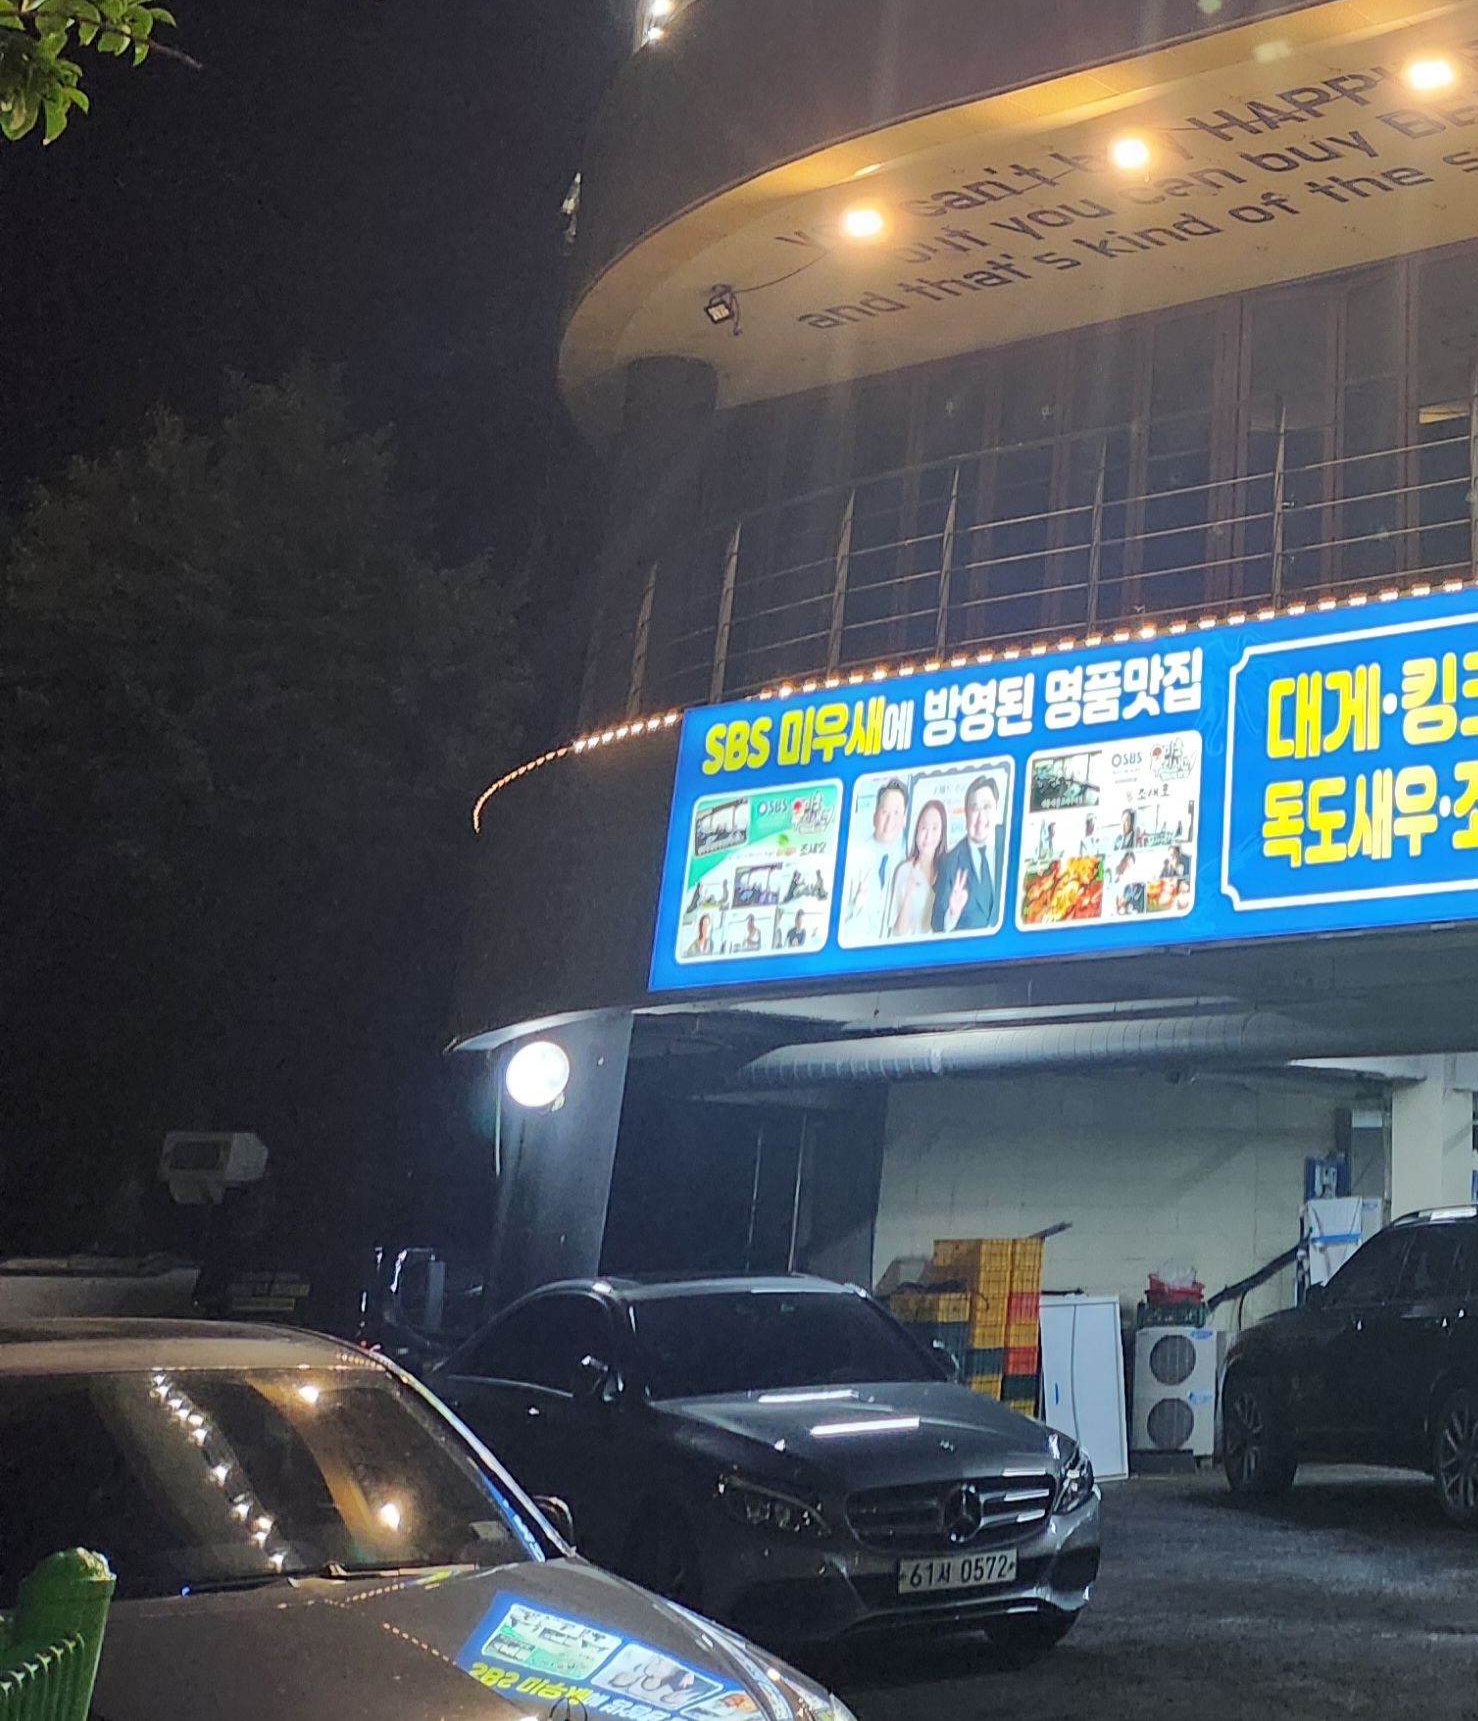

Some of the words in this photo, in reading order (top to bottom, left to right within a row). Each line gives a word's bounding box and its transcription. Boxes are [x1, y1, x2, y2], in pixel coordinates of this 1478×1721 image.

[991, 195, 1117, 242] you
[1116, 166, 1245, 207] can
[1239, 130, 1380, 173] buy
[797, 291, 908, 332] and
[898, 250, 1081, 304] that's
[1071, 212, 1224, 260] kind
[1227, 190, 1301, 225] of
[1306, 165, 1436, 206] the
[702, 714, 772, 776] SBS
[777, 694, 914, 767] 미우새에
[922, 672, 1036, 748] 방영된
[1043, 646, 1204, 731] 명품맛집
[1137, 782, 1171, 801] 조새호
[960, 1554, 1009, 1584] 0572
